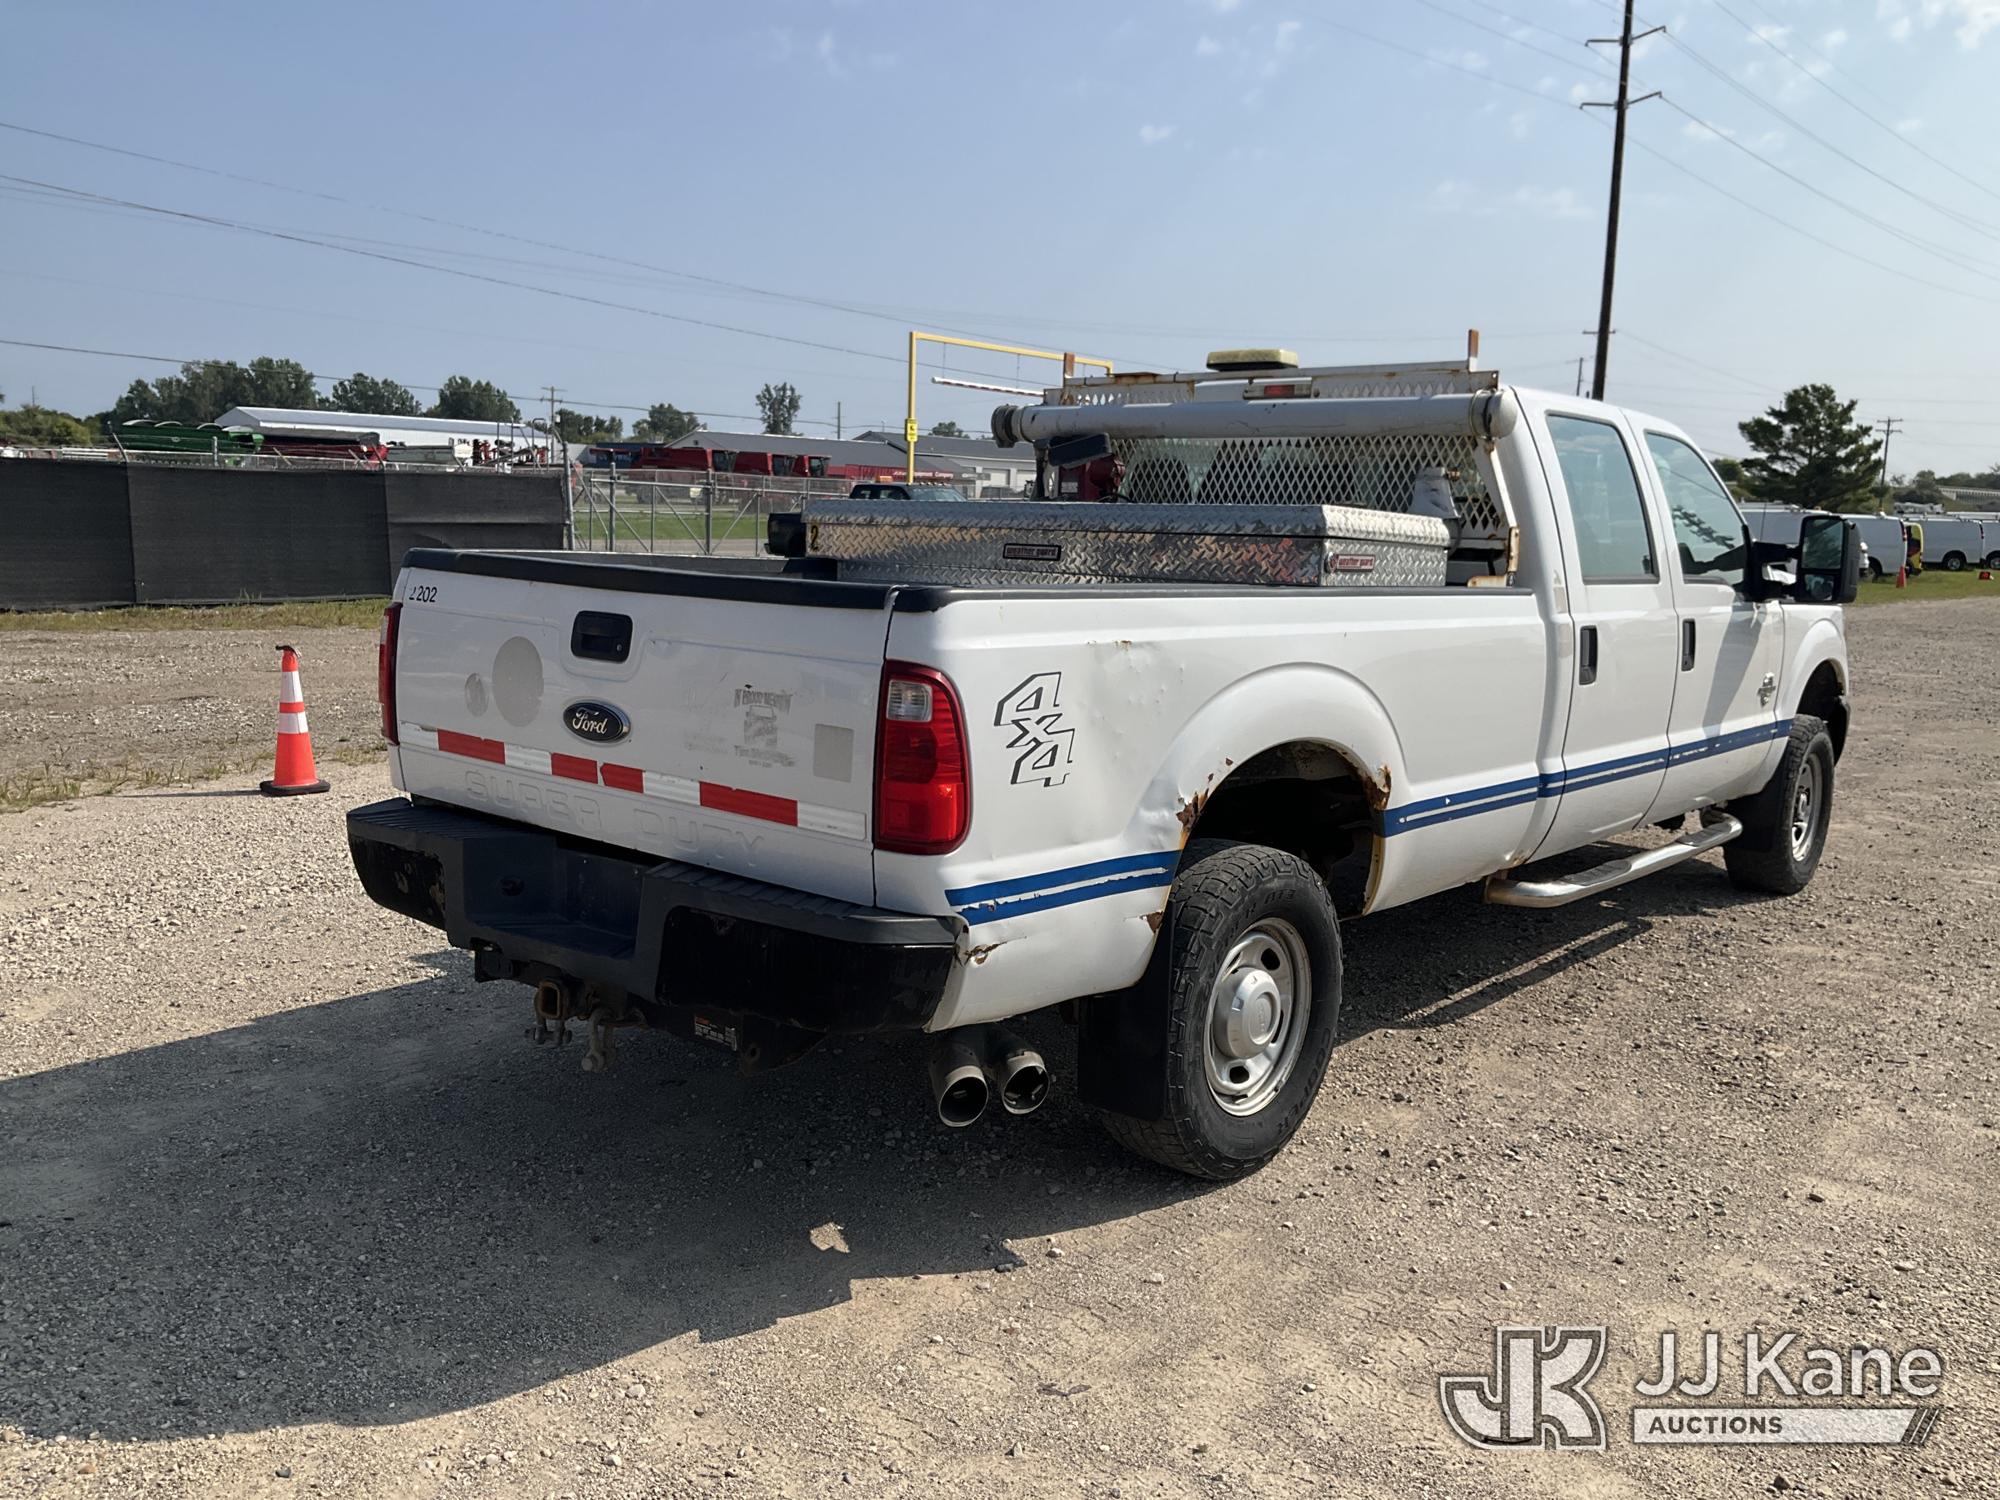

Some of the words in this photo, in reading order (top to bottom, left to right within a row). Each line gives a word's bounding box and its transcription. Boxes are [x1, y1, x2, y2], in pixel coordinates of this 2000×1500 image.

[572, 707, 608, 735] Ford
[464, 769, 603, 832] SUPER
[633, 807, 765, 866] DUTY
